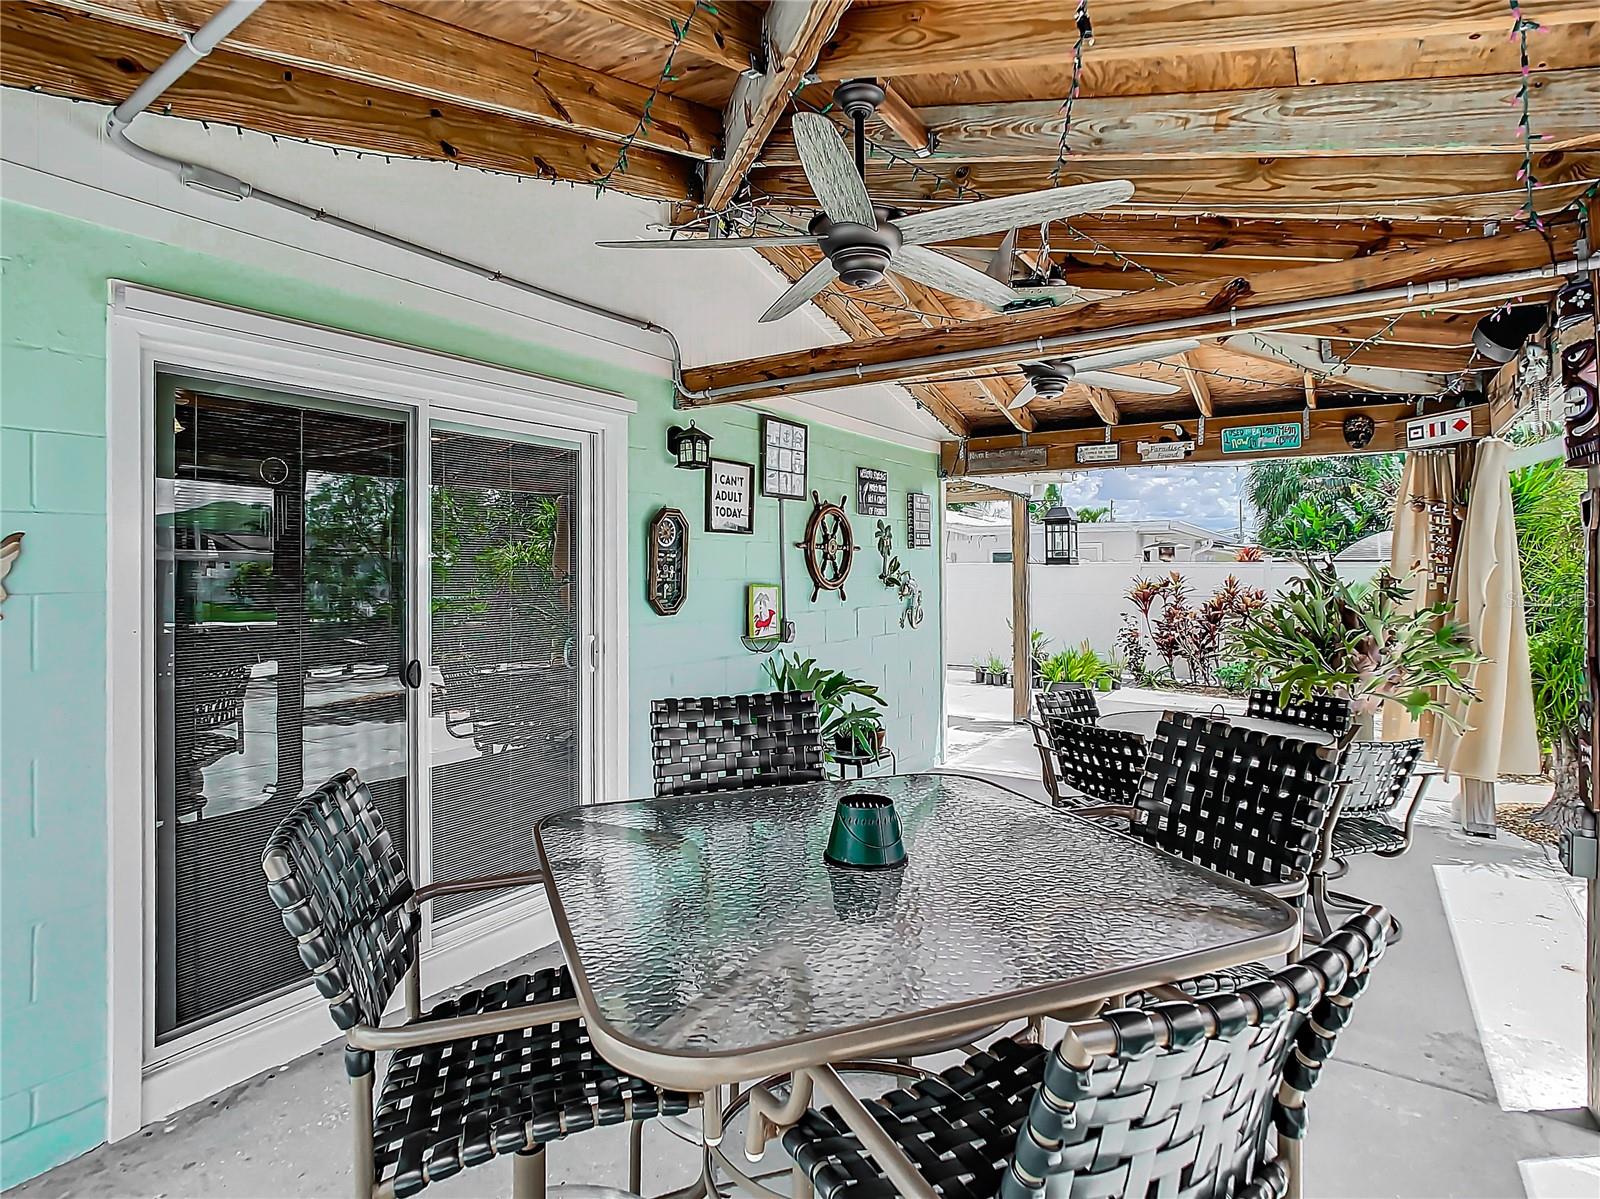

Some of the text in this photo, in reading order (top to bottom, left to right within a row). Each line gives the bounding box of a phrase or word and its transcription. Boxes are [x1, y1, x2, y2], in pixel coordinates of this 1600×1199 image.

[1150, 442, 1181, 453] Paradise
[1158, 451, 1179, 459] Found
[714, 473, 744, 487] I CAN'T
[715, 490, 743, 503] ADULT
[715, 506, 742, 518] TODAY
